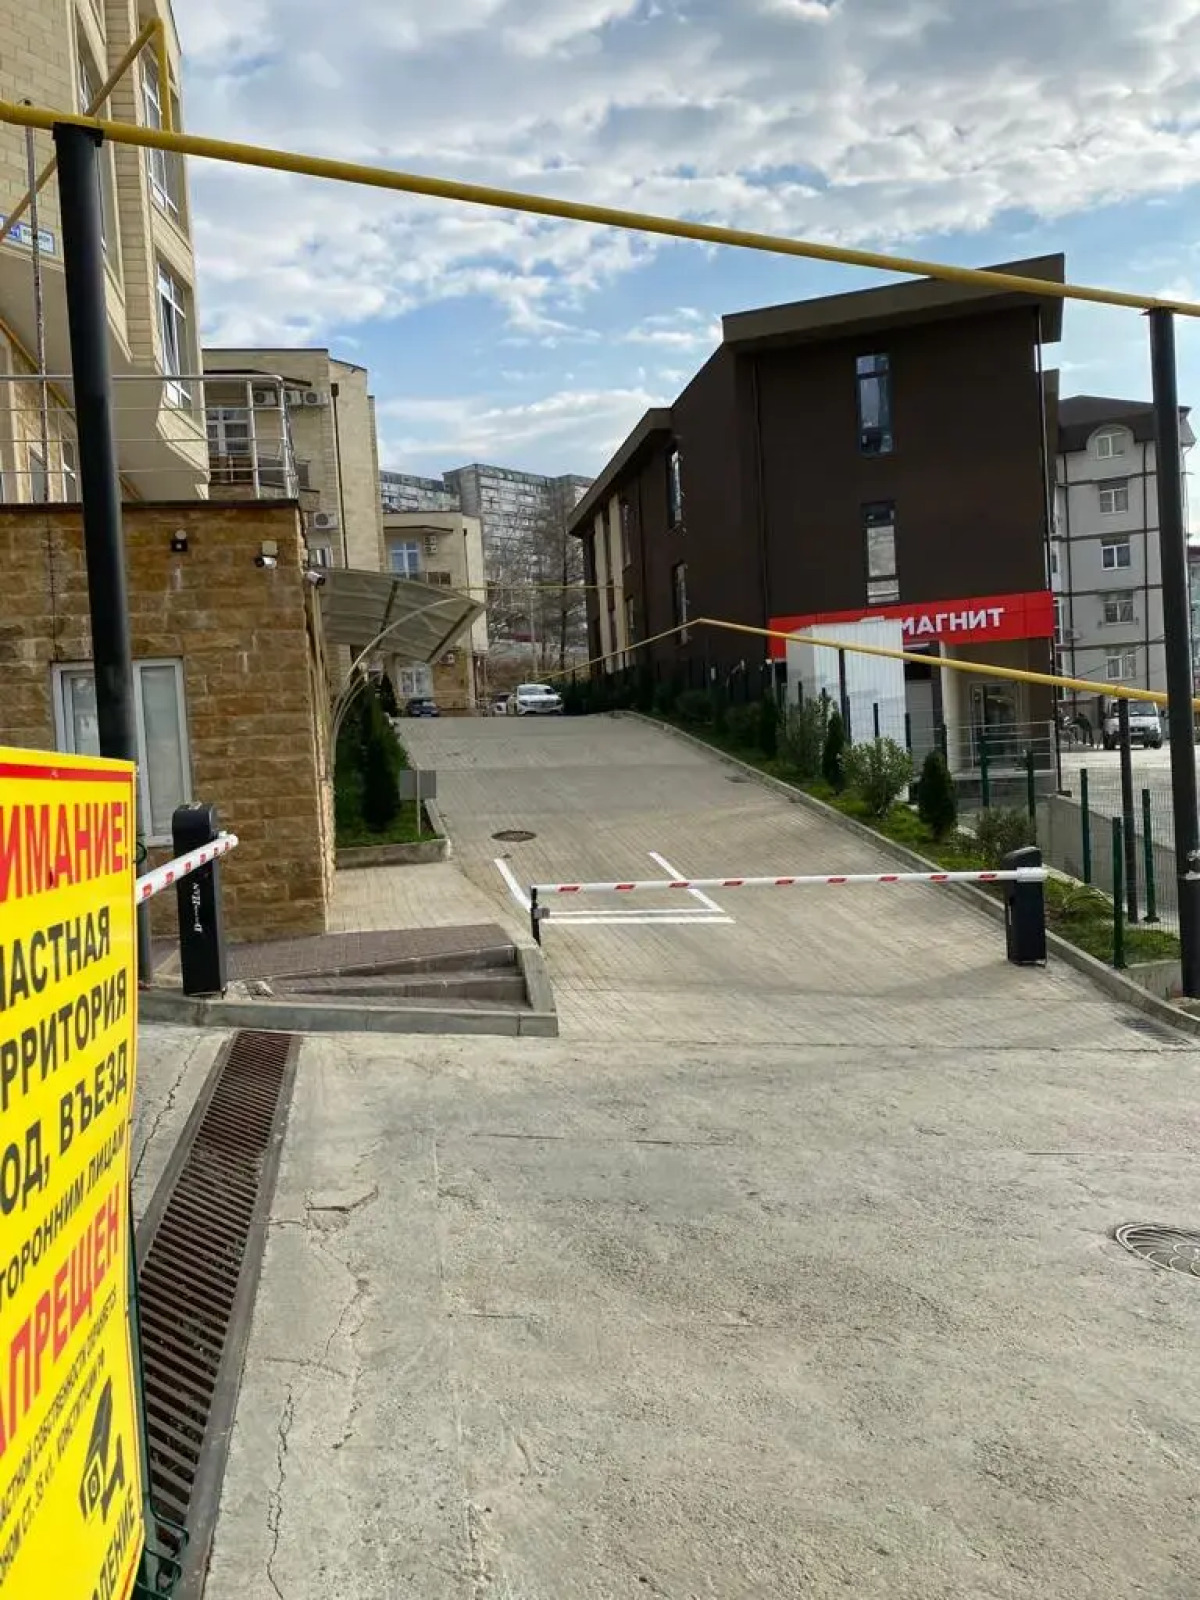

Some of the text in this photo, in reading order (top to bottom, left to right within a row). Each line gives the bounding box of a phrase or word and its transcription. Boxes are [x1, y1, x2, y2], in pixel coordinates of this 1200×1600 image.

[901, 607, 1004, 635] МАГНИТ
[0, 801, 128, 902] ИМАНИЕ!
[60, 1039, 128, 1156] ВЪЕЗД
[87, 1119, 126, 1195] ЛИЦАМ
